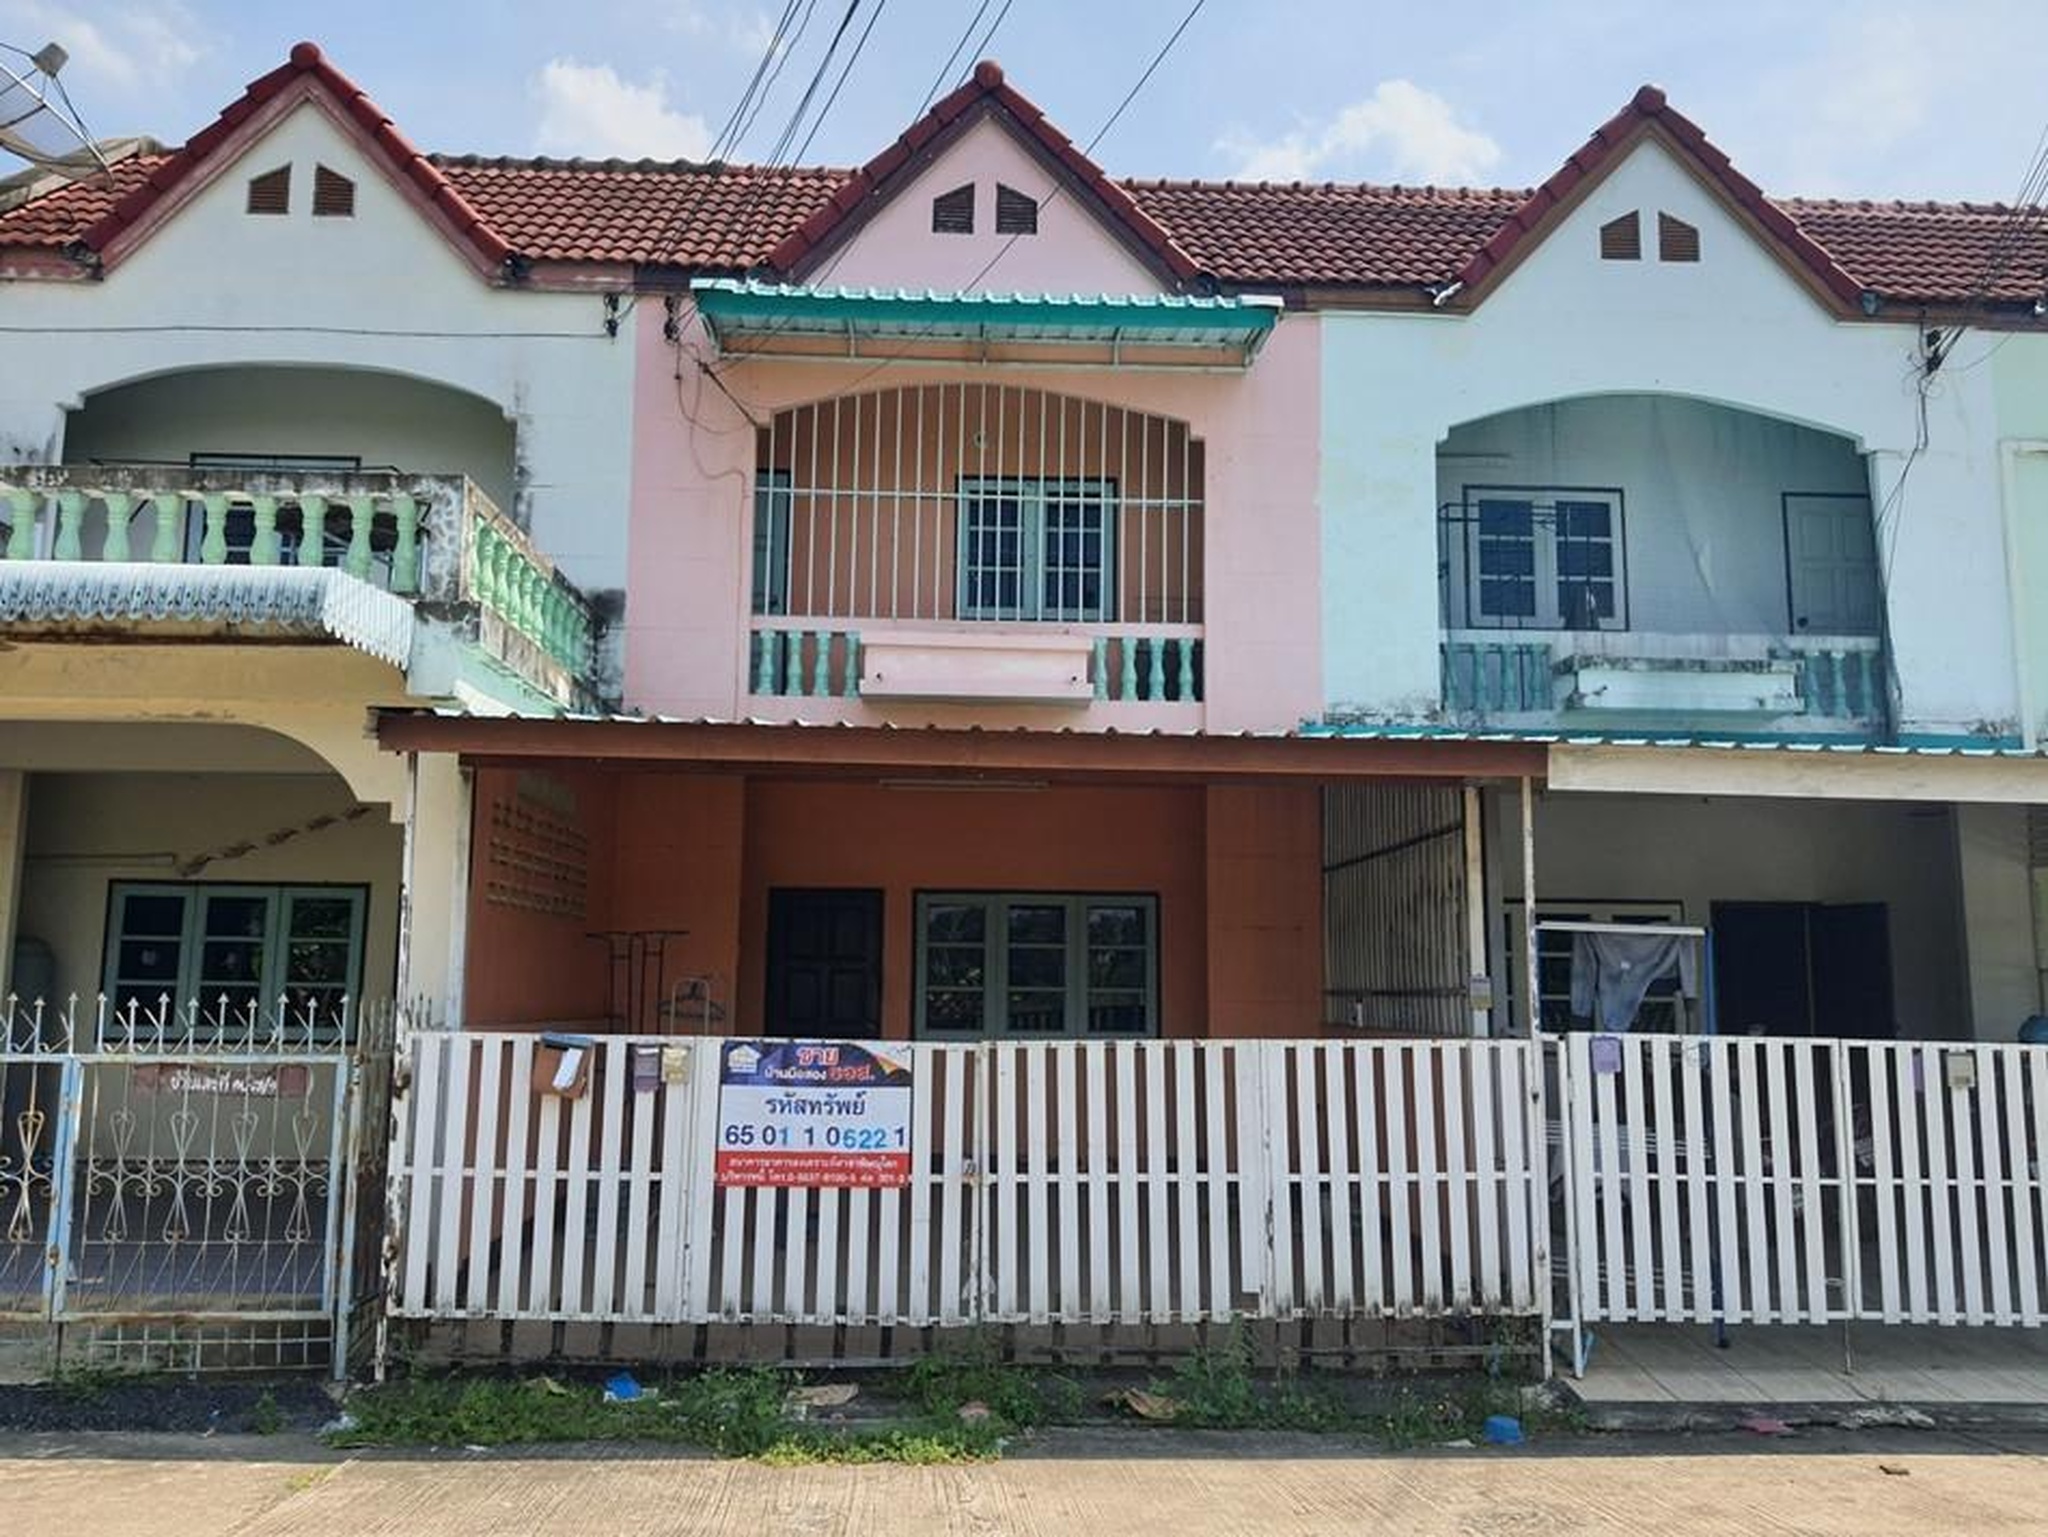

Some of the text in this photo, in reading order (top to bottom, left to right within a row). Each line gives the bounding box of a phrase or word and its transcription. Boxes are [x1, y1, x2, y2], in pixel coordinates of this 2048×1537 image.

[796, 1047, 839, 1065] ขาย
[764, 1067, 826, 1080] บ้านมือสอง
[766, 1091, 867, 1115] รหัสทรัพย์
[725, 1125, 754, 1145] 65
[762, 1125, 789, 1146] 01
